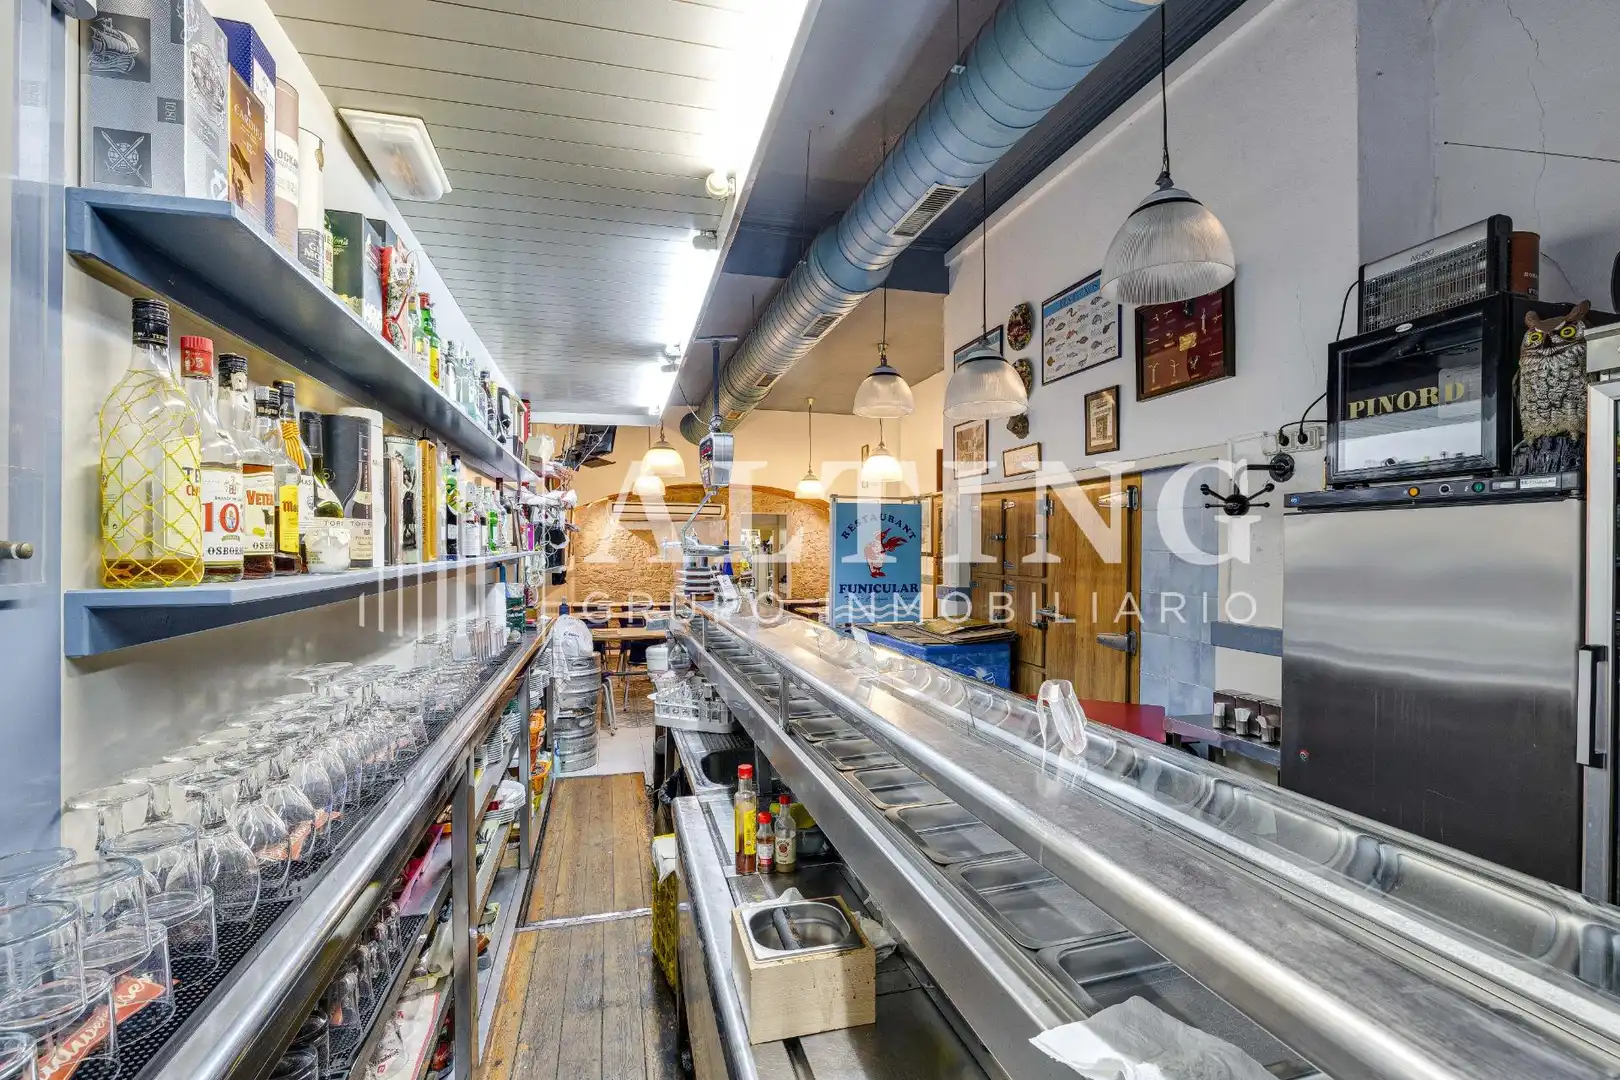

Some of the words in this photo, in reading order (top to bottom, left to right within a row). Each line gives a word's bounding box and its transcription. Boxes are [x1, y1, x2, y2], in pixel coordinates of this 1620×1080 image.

[1348, 383, 1465, 419] PINORD
[201, 501, 243, 534] 10
[841, 513, 917, 540] RESTAURANT
[838, 583, 919, 594] FUNICULAR
